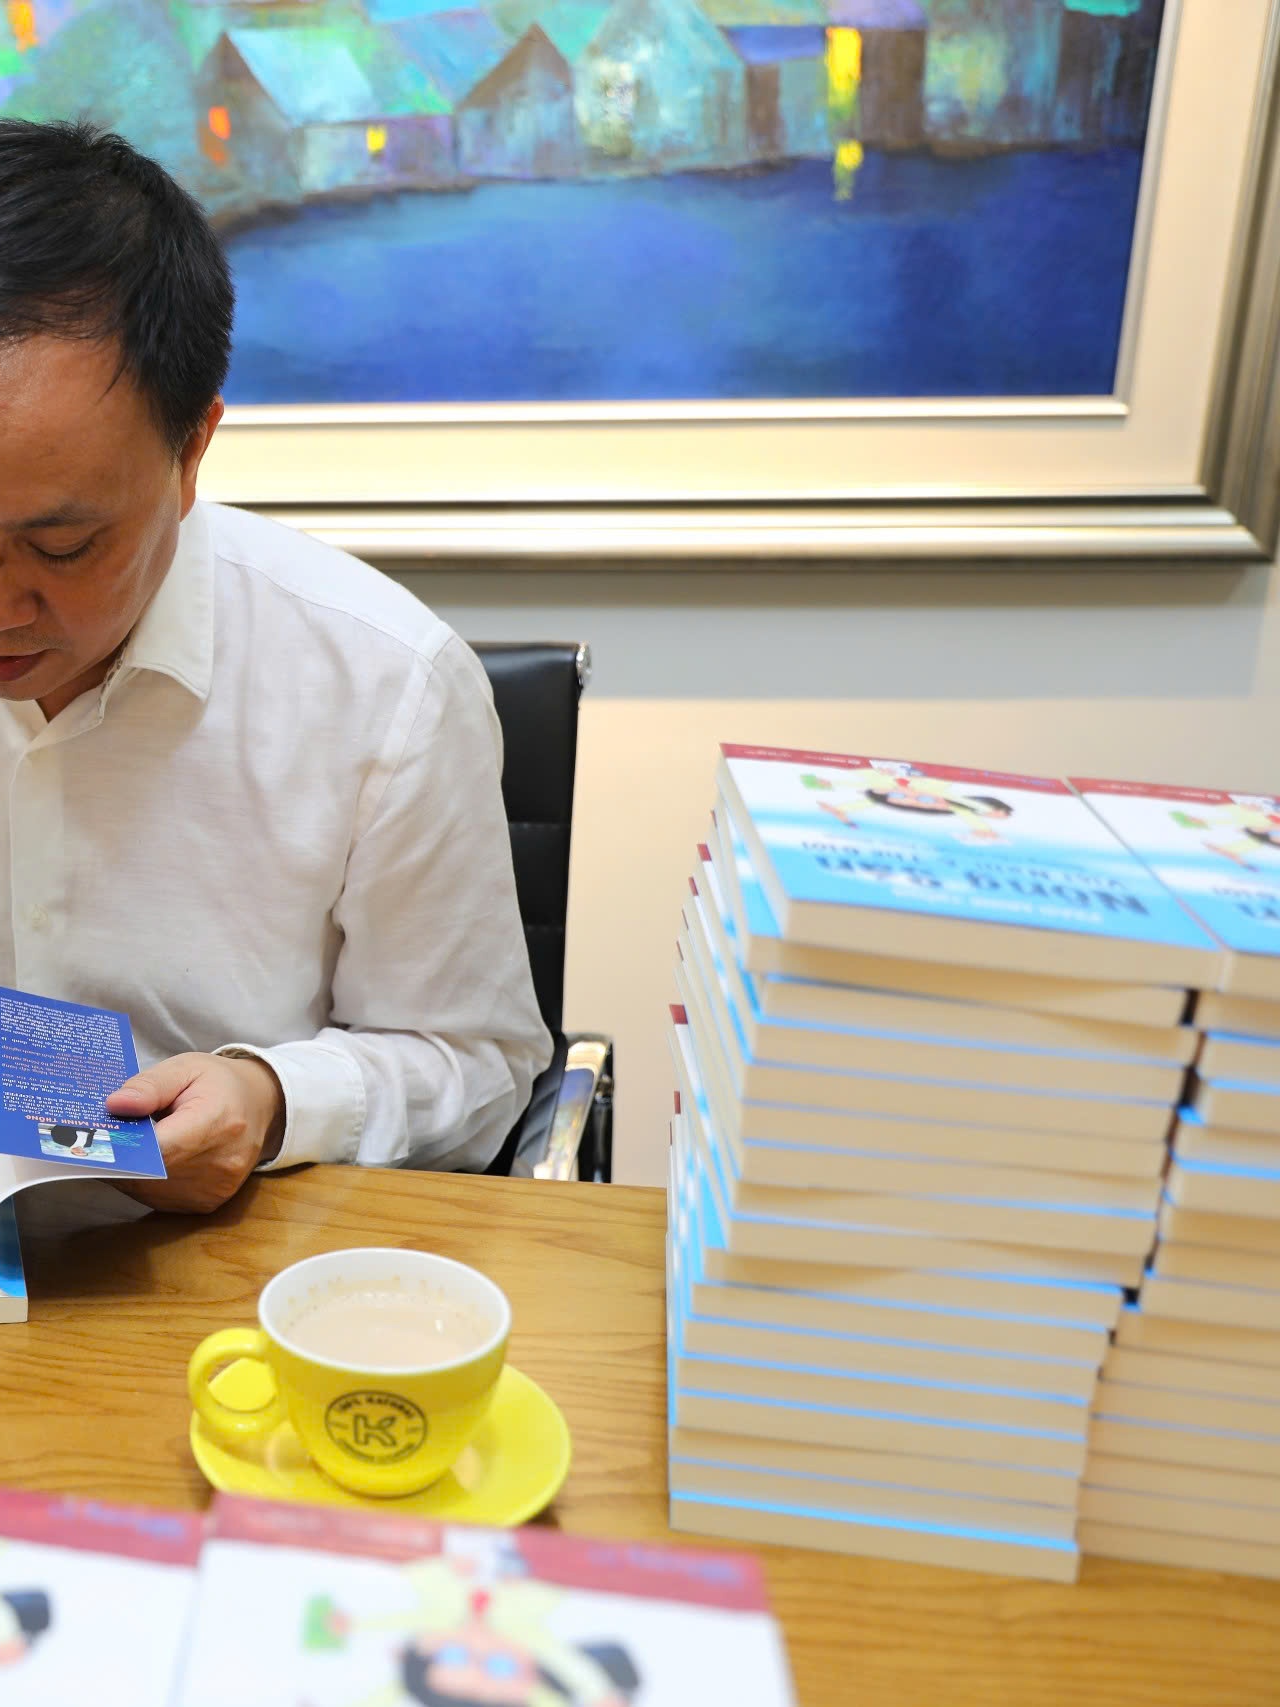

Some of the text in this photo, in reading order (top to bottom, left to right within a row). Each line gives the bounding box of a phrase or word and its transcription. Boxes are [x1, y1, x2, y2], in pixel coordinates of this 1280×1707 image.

[25, 1115, 58, 1124] THÔNG
[92, 1122, 120, 1130] PHAN
[353, 1414, 396, 1447] K
